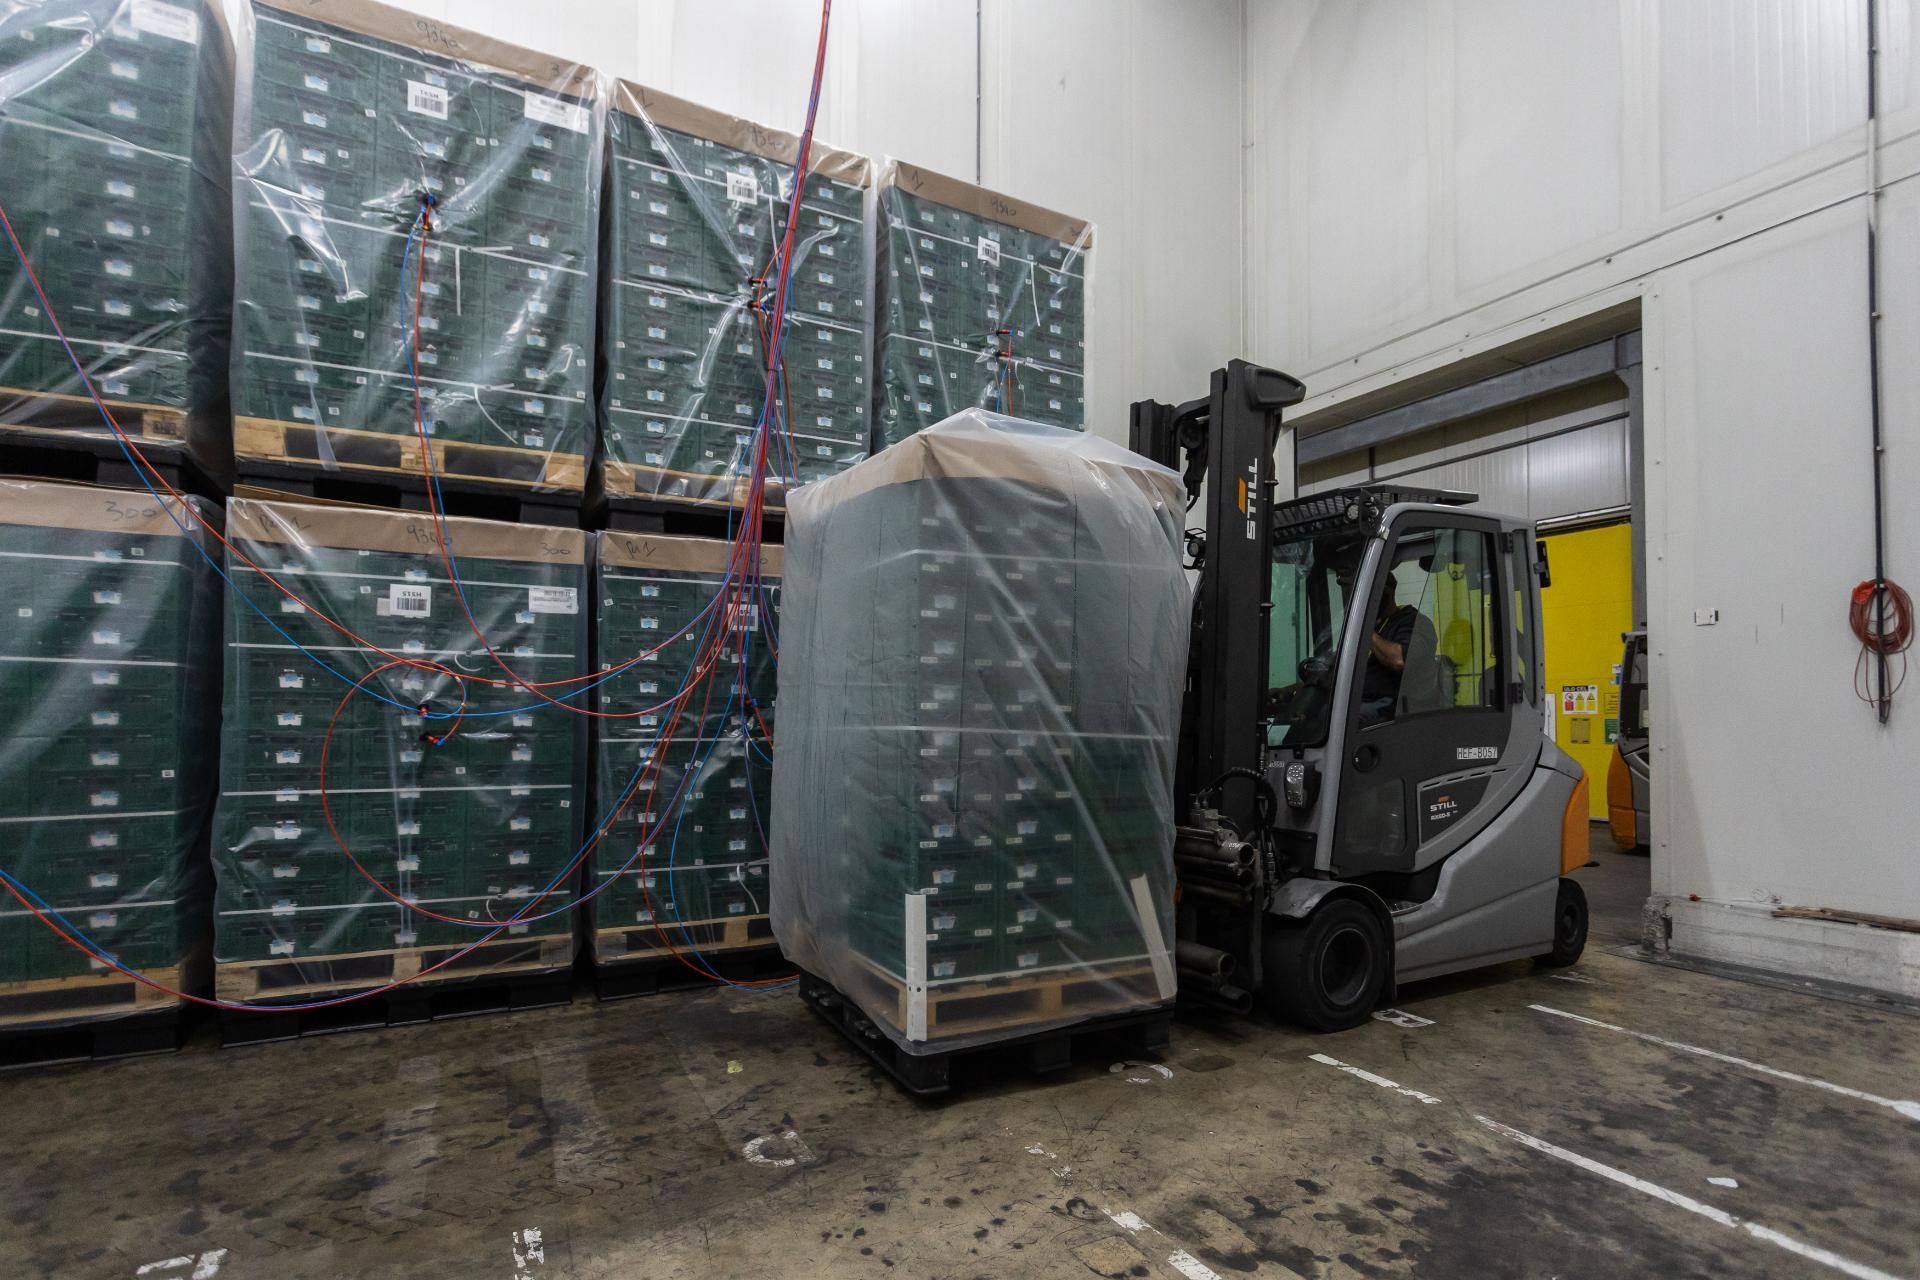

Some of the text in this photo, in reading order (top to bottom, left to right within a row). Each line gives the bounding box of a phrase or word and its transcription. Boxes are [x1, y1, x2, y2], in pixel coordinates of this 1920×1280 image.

[1246, 457, 1258, 540] STILL
[105, 501, 157, 522] 300
[1457, 747, 1497, 759] HEF-B057
[1430, 801, 1457, 812] STILL
